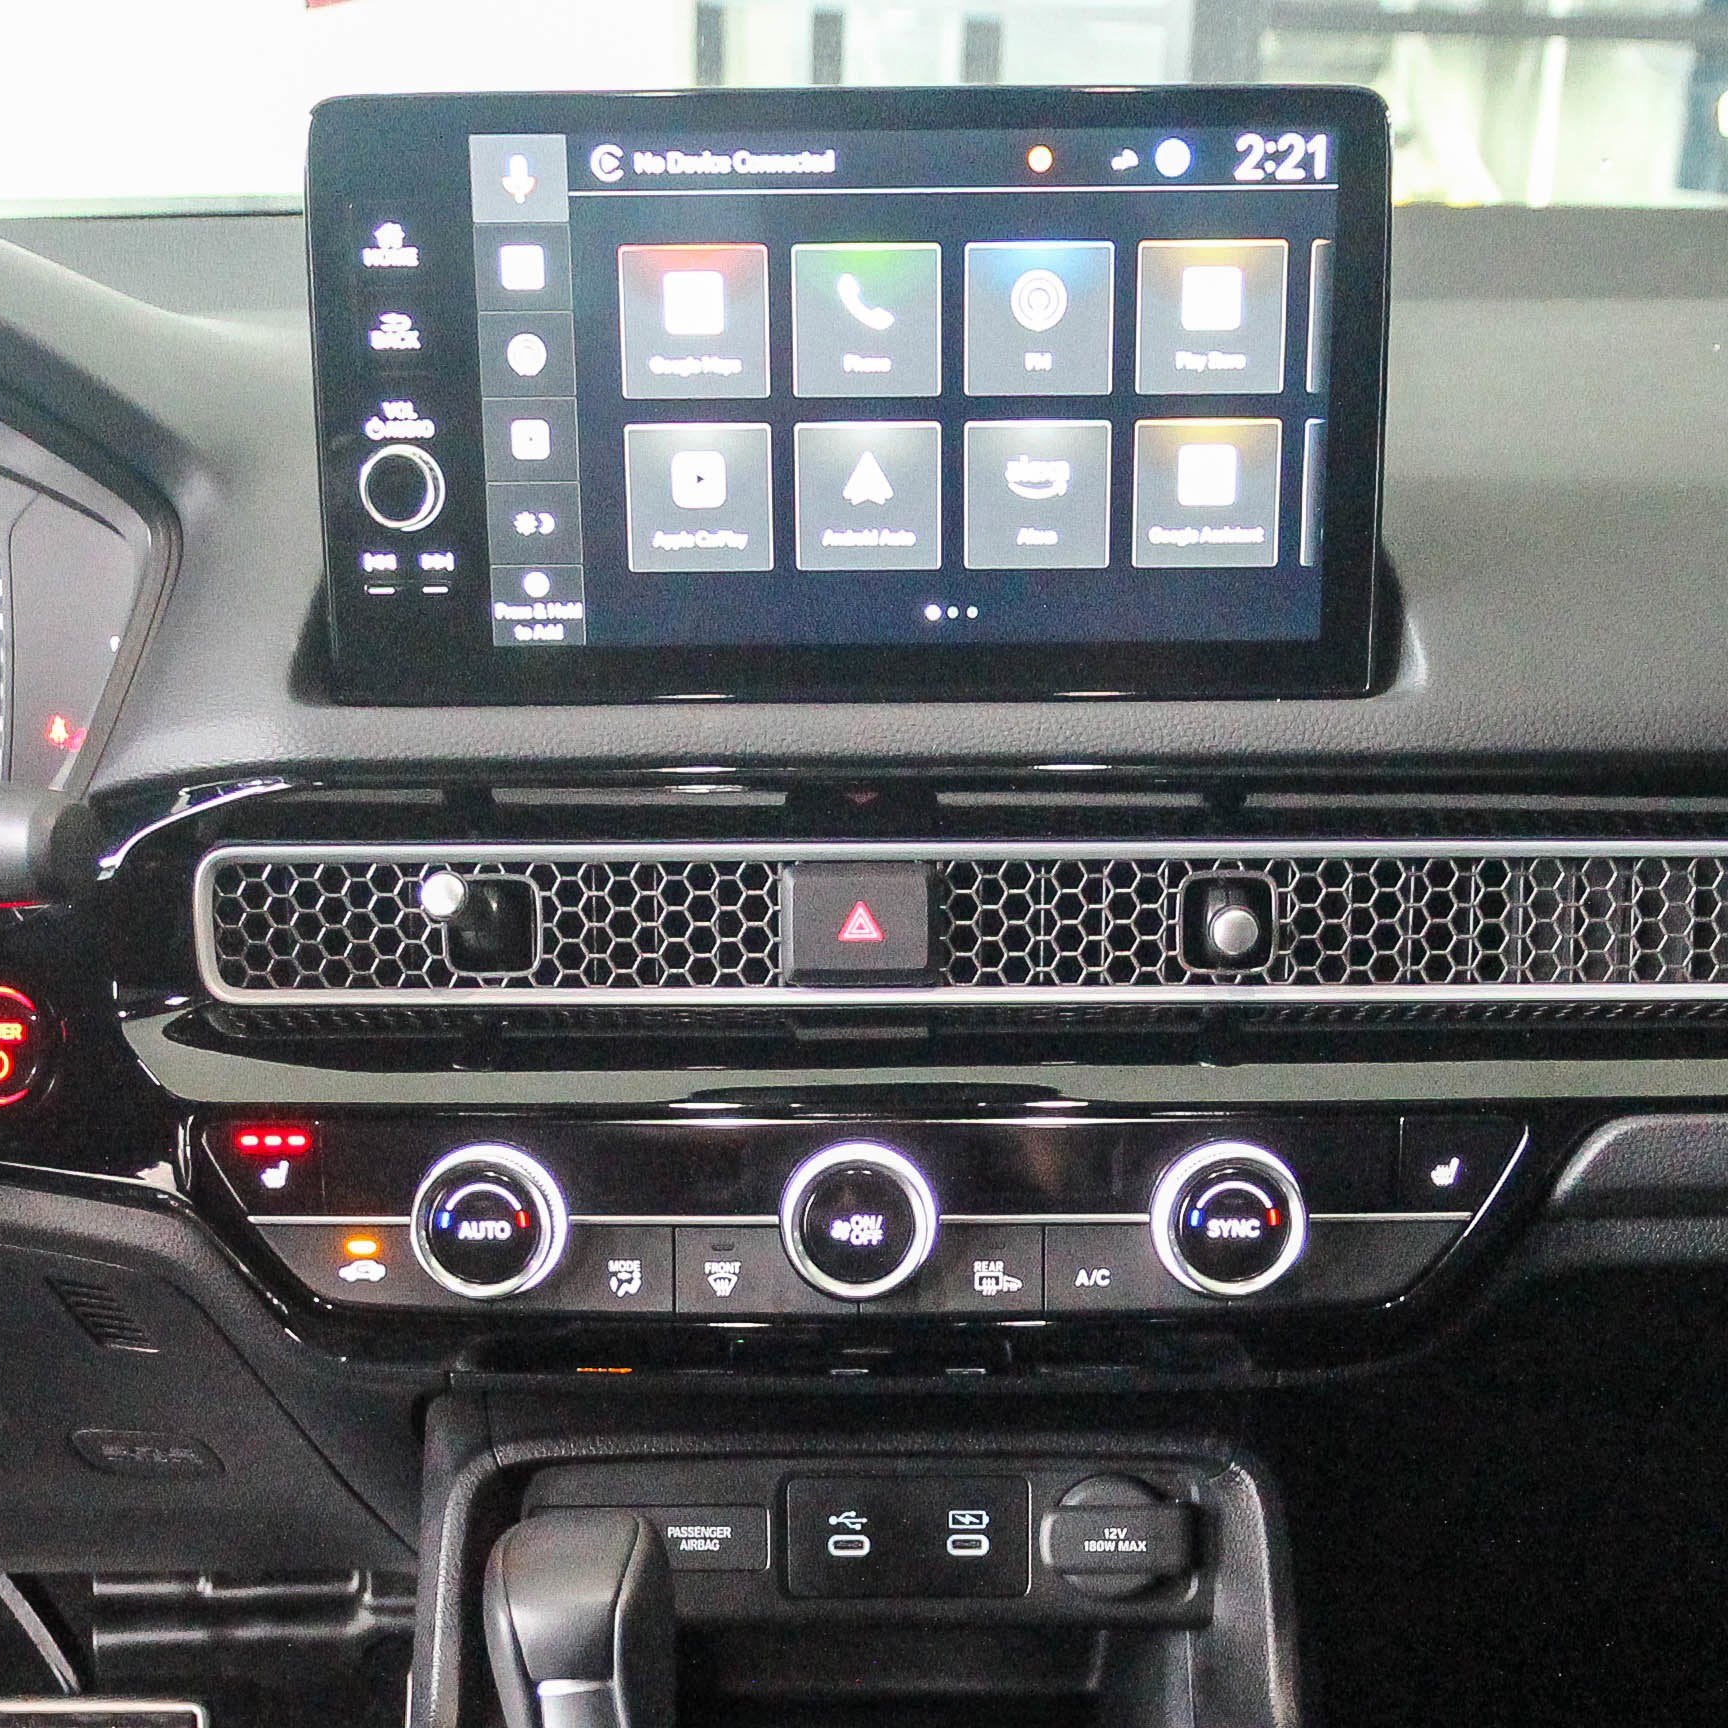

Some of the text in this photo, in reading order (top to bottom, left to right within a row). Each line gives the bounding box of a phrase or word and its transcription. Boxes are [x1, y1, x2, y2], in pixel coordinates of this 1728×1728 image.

[633, 149, 836, 174] No Device Connected
[1233, 132, 1327, 181] 2:21
[850, 1212, 883, 1229] ON/
[1206, 1217, 1260, 1238] SYNC
[457, 1219, 512, 1242] AUTO
[850, 1229, 883, 1246] OFF
[608, 1260, 642, 1274] MODE
[704, 1261, 742, 1275] FRONT
[973, 1260, 1005, 1274] REAR
[1075, 1269, 1111, 1287] A/C
[667, 1526, 732, 1540] PASSENGER
[1103, 1528, 1128, 1541] 12V
[679, 1538, 721, 1552] AIRBAG
[1083, 1540, 1148, 1553] 180W MAX
